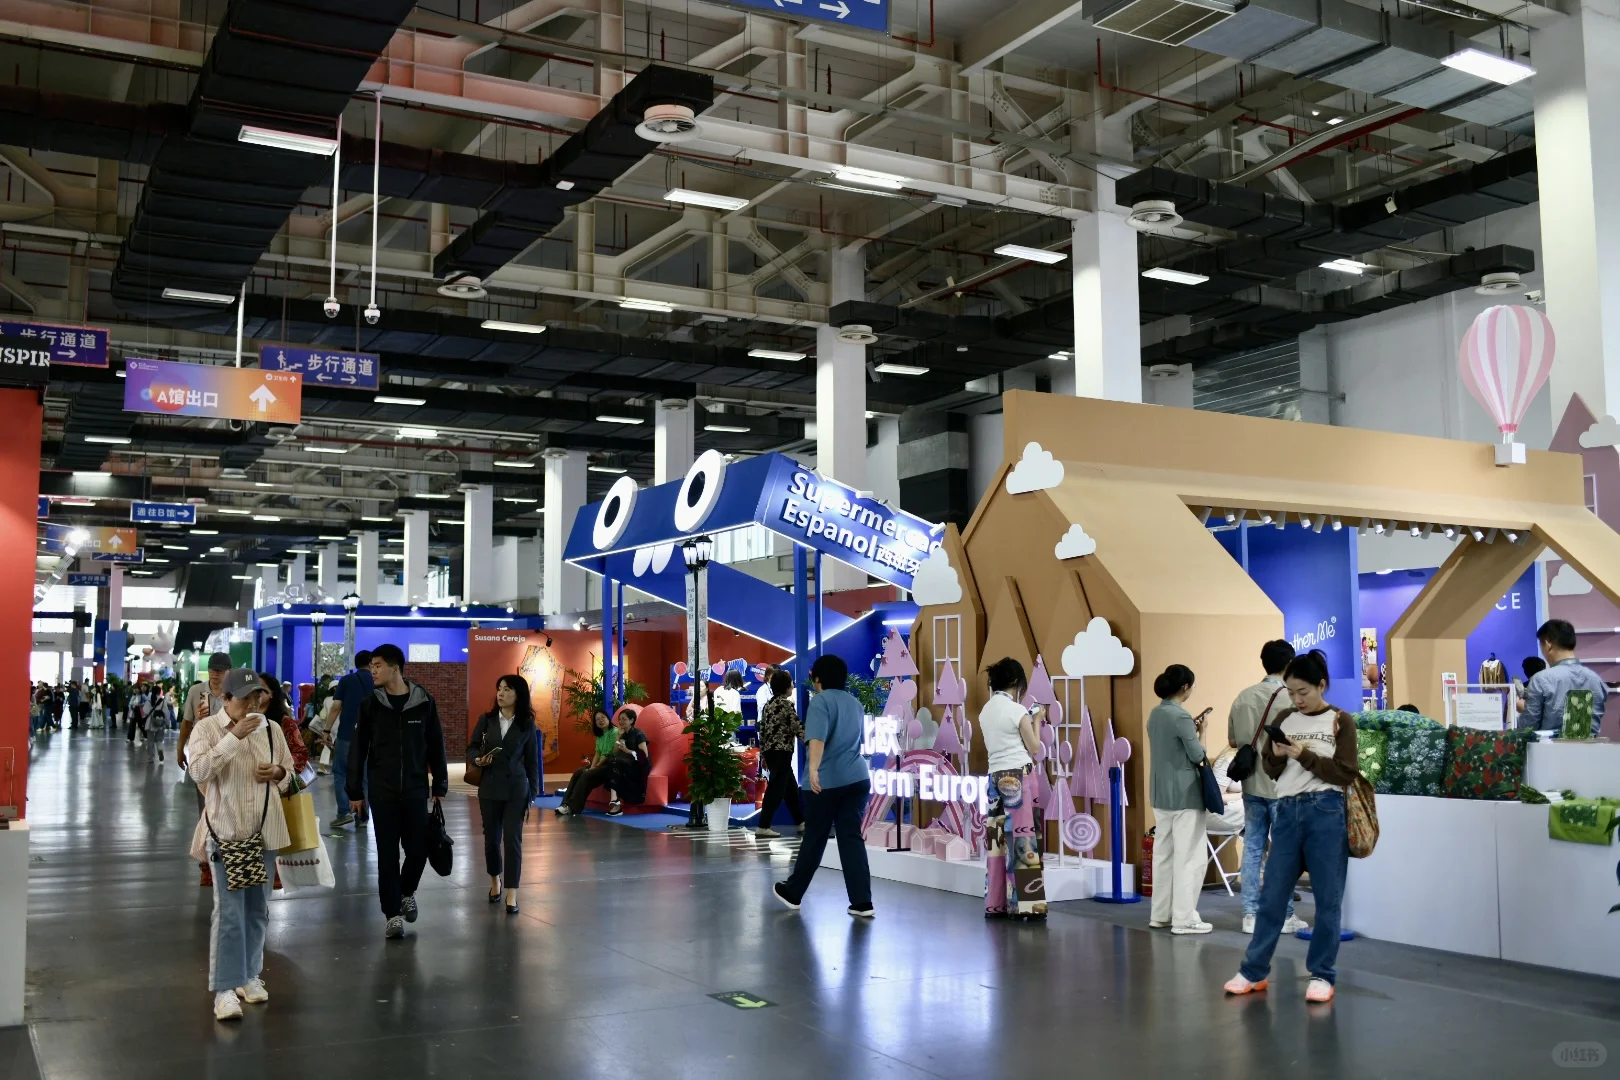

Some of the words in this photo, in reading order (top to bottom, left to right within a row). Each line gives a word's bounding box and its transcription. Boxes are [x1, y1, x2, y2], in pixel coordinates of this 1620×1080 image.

[0, 346, 51, 368] SPIR
[307, 353, 374, 377] 步行通道
[156, 387, 219, 408] A馆出口
[137, 506, 176, 518] 通往B馆
[502, 635, 526, 643] Cereja
[245, 674, 253, 682] M
[869, 767, 915, 799] ern
